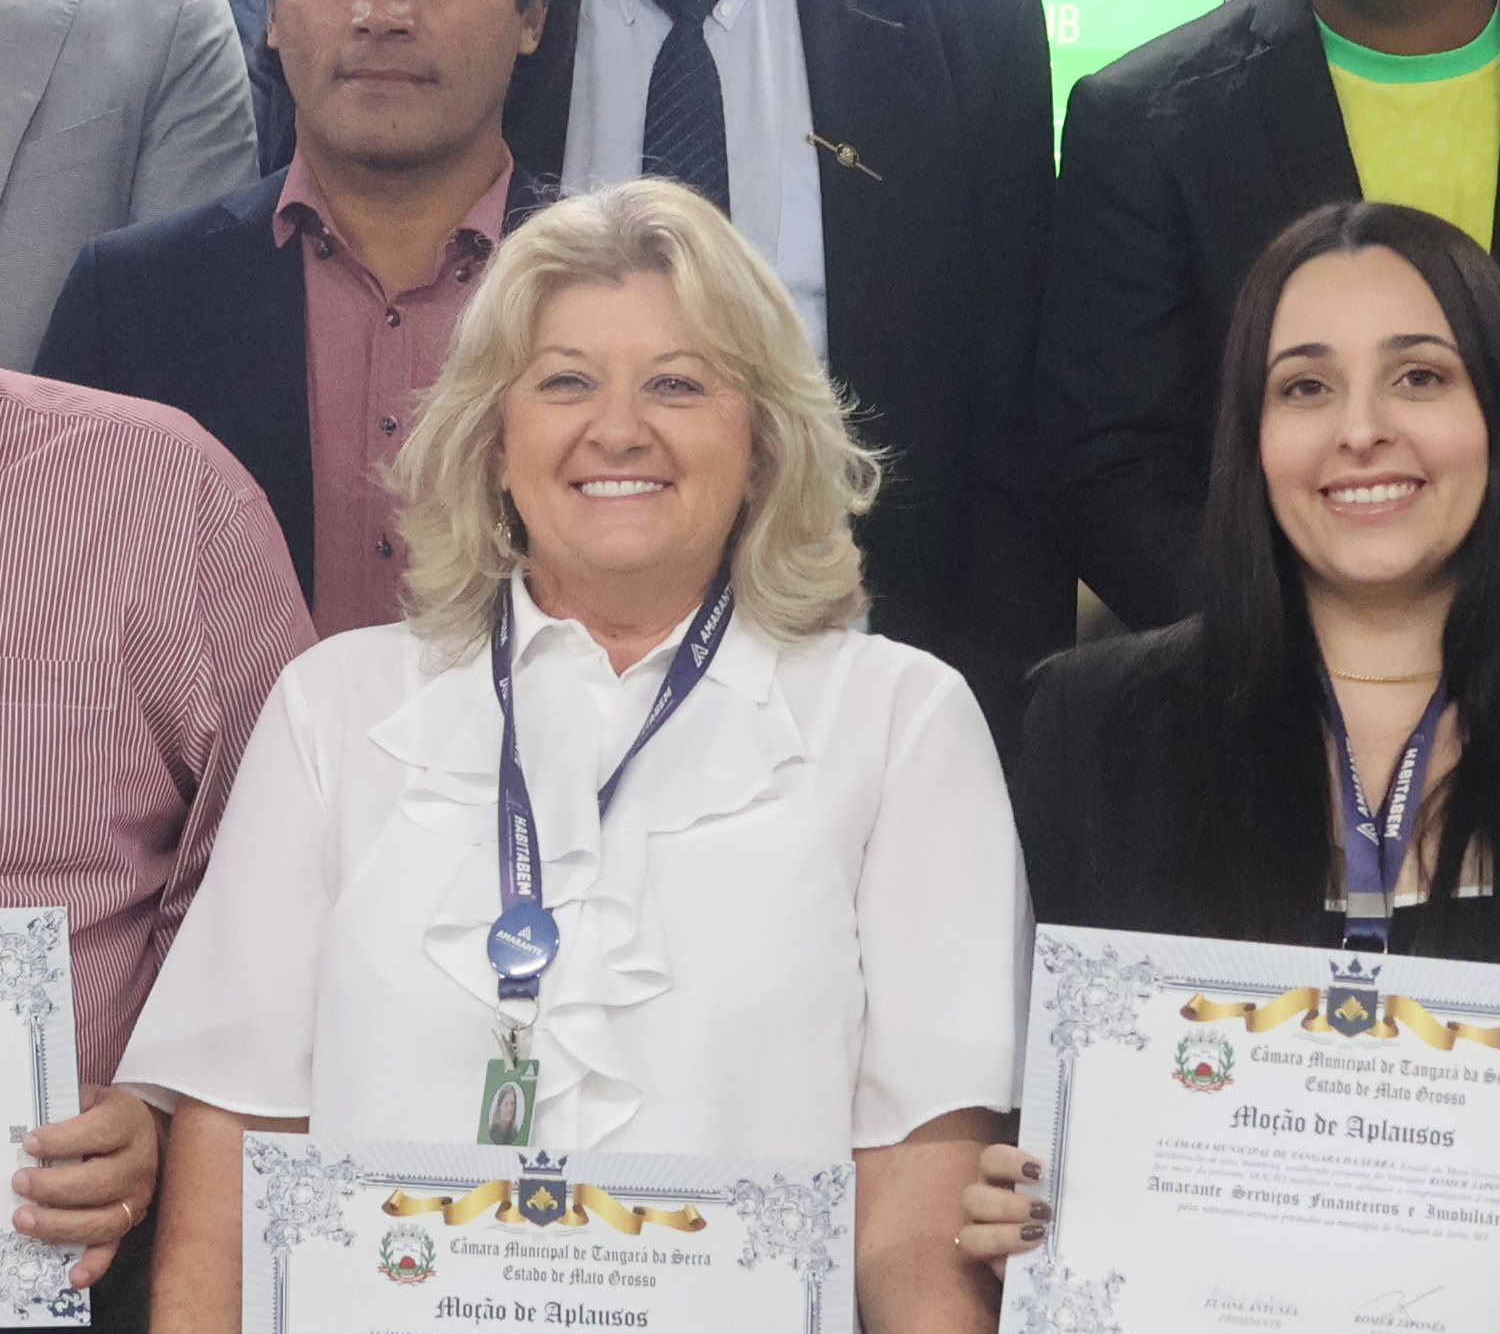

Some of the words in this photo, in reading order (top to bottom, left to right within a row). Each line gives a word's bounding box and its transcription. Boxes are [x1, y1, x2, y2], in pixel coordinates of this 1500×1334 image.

[1384, 747, 1418, 838] HABITABEM
[514, 814, 532, 896] HABITABEM
[496, 929, 544, 958] AMARANTE
[1250, 1044, 1302, 1065] Câmara
[1306, 1050, 1375, 1073] Municipal
[1379, 1059, 1394, 1074] de
[1400, 1059, 1458, 1081] Tangará
[1463, 1065, 1478, 1082] da
[1304, 1075, 1351, 1095] Estado
[1355, 1081, 1369, 1096] de
[1373, 1082, 1411, 1100] Mato
[1415, 1085, 1465, 1105] Grosso
[1229, 1104, 1306, 1136] Moção
[1313, 1112, 1338, 1136] de
[1345, 1114, 1454, 1148] Aplausos
[1147, 1175, 1221, 1197] Amarante
[1231, 1184, 1299, 1205] Serviços
[1310, 1192, 1399, 1215] Financeiros
[1408, 1206, 1415, 1217] e
[449, 1236, 499, 1256] Câmara
[503, 1240, 568, 1261] Municipal
[573, 1245, 586, 1260] de
[591, 1244, 647, 1265] Tangará
[652, 1248, 666, 1264] da
[670, 1248, 711, 1265] Serra
[502, 1264, 547, 1282] Estado
[550, 1268, 564, 1283] de
[568, 1267, 604, 1285] Mato
[607, 1269, 656, 1287] Grosso
[434, 1295, 506, 1325] Moção
[513, 1299, 537, 1323] de
[543, 1300, 648, 1328] Aplausos
